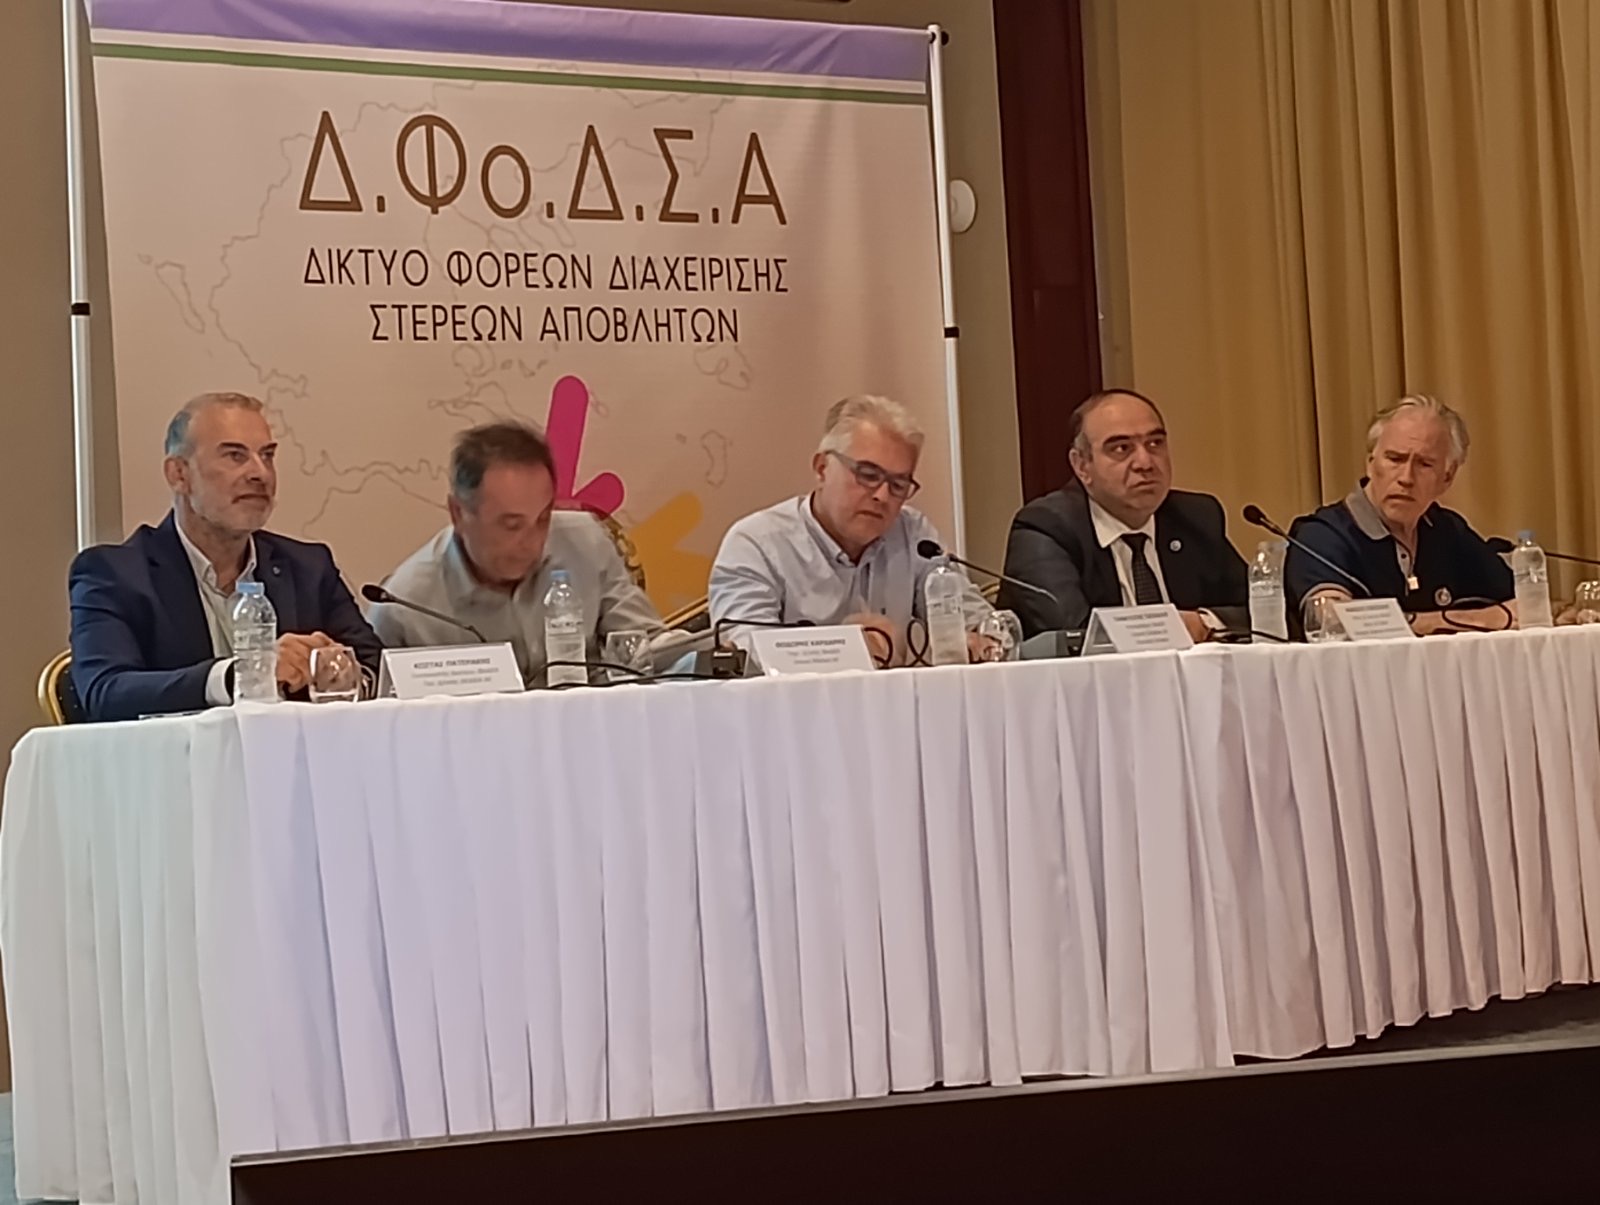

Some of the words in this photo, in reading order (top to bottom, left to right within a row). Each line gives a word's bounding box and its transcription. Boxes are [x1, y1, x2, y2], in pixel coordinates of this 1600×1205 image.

[303, 247, 429, 287] ΔΙΚΤΥΟ
[446, 250, 592, 289] ΦΟΡΕΩΝ
[608, 255, 789, 292] ΔΙΑΧΕΙΡΙΣΗΣ
[369, 304, 523, 342] ΣΤΕΡΕΩΝ
[539, 306, 739, 343] ΑΠΟΒΛΗΤΩΝ
